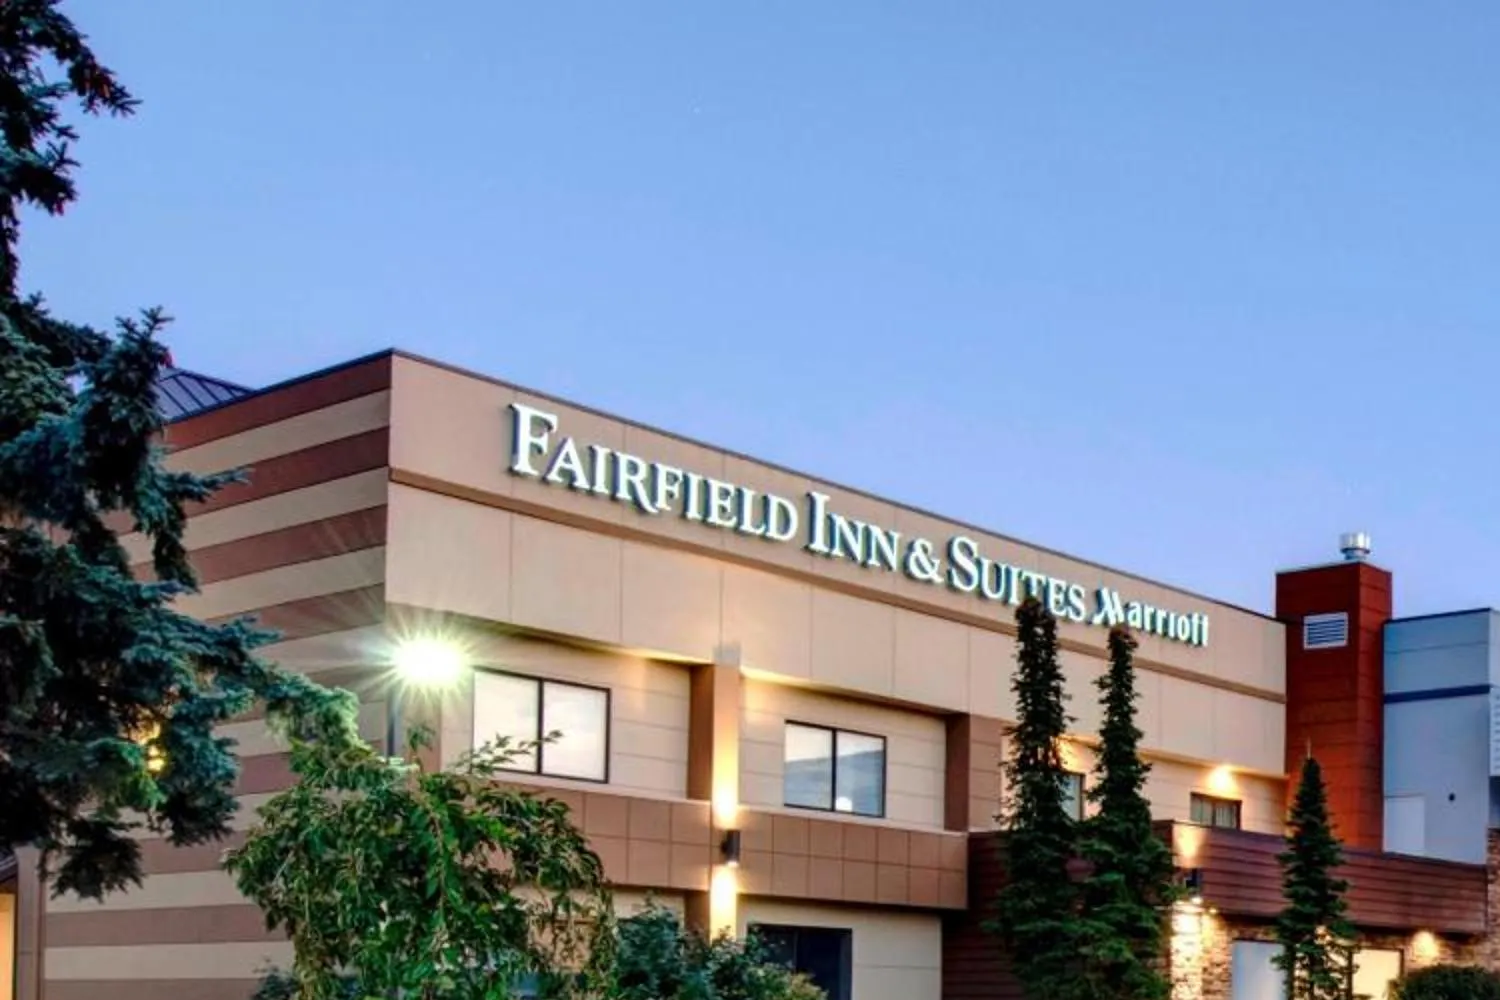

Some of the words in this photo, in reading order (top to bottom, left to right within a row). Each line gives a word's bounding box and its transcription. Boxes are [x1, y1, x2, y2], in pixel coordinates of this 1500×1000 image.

[506, 402, 799, 543] FAIRFIELD
[807, 490, 901, 572] INN
[907, 538, 945, 584] &
[950, 536, 1086, 622] SUITES
[1092, 586, 1209, 647] Marriott
